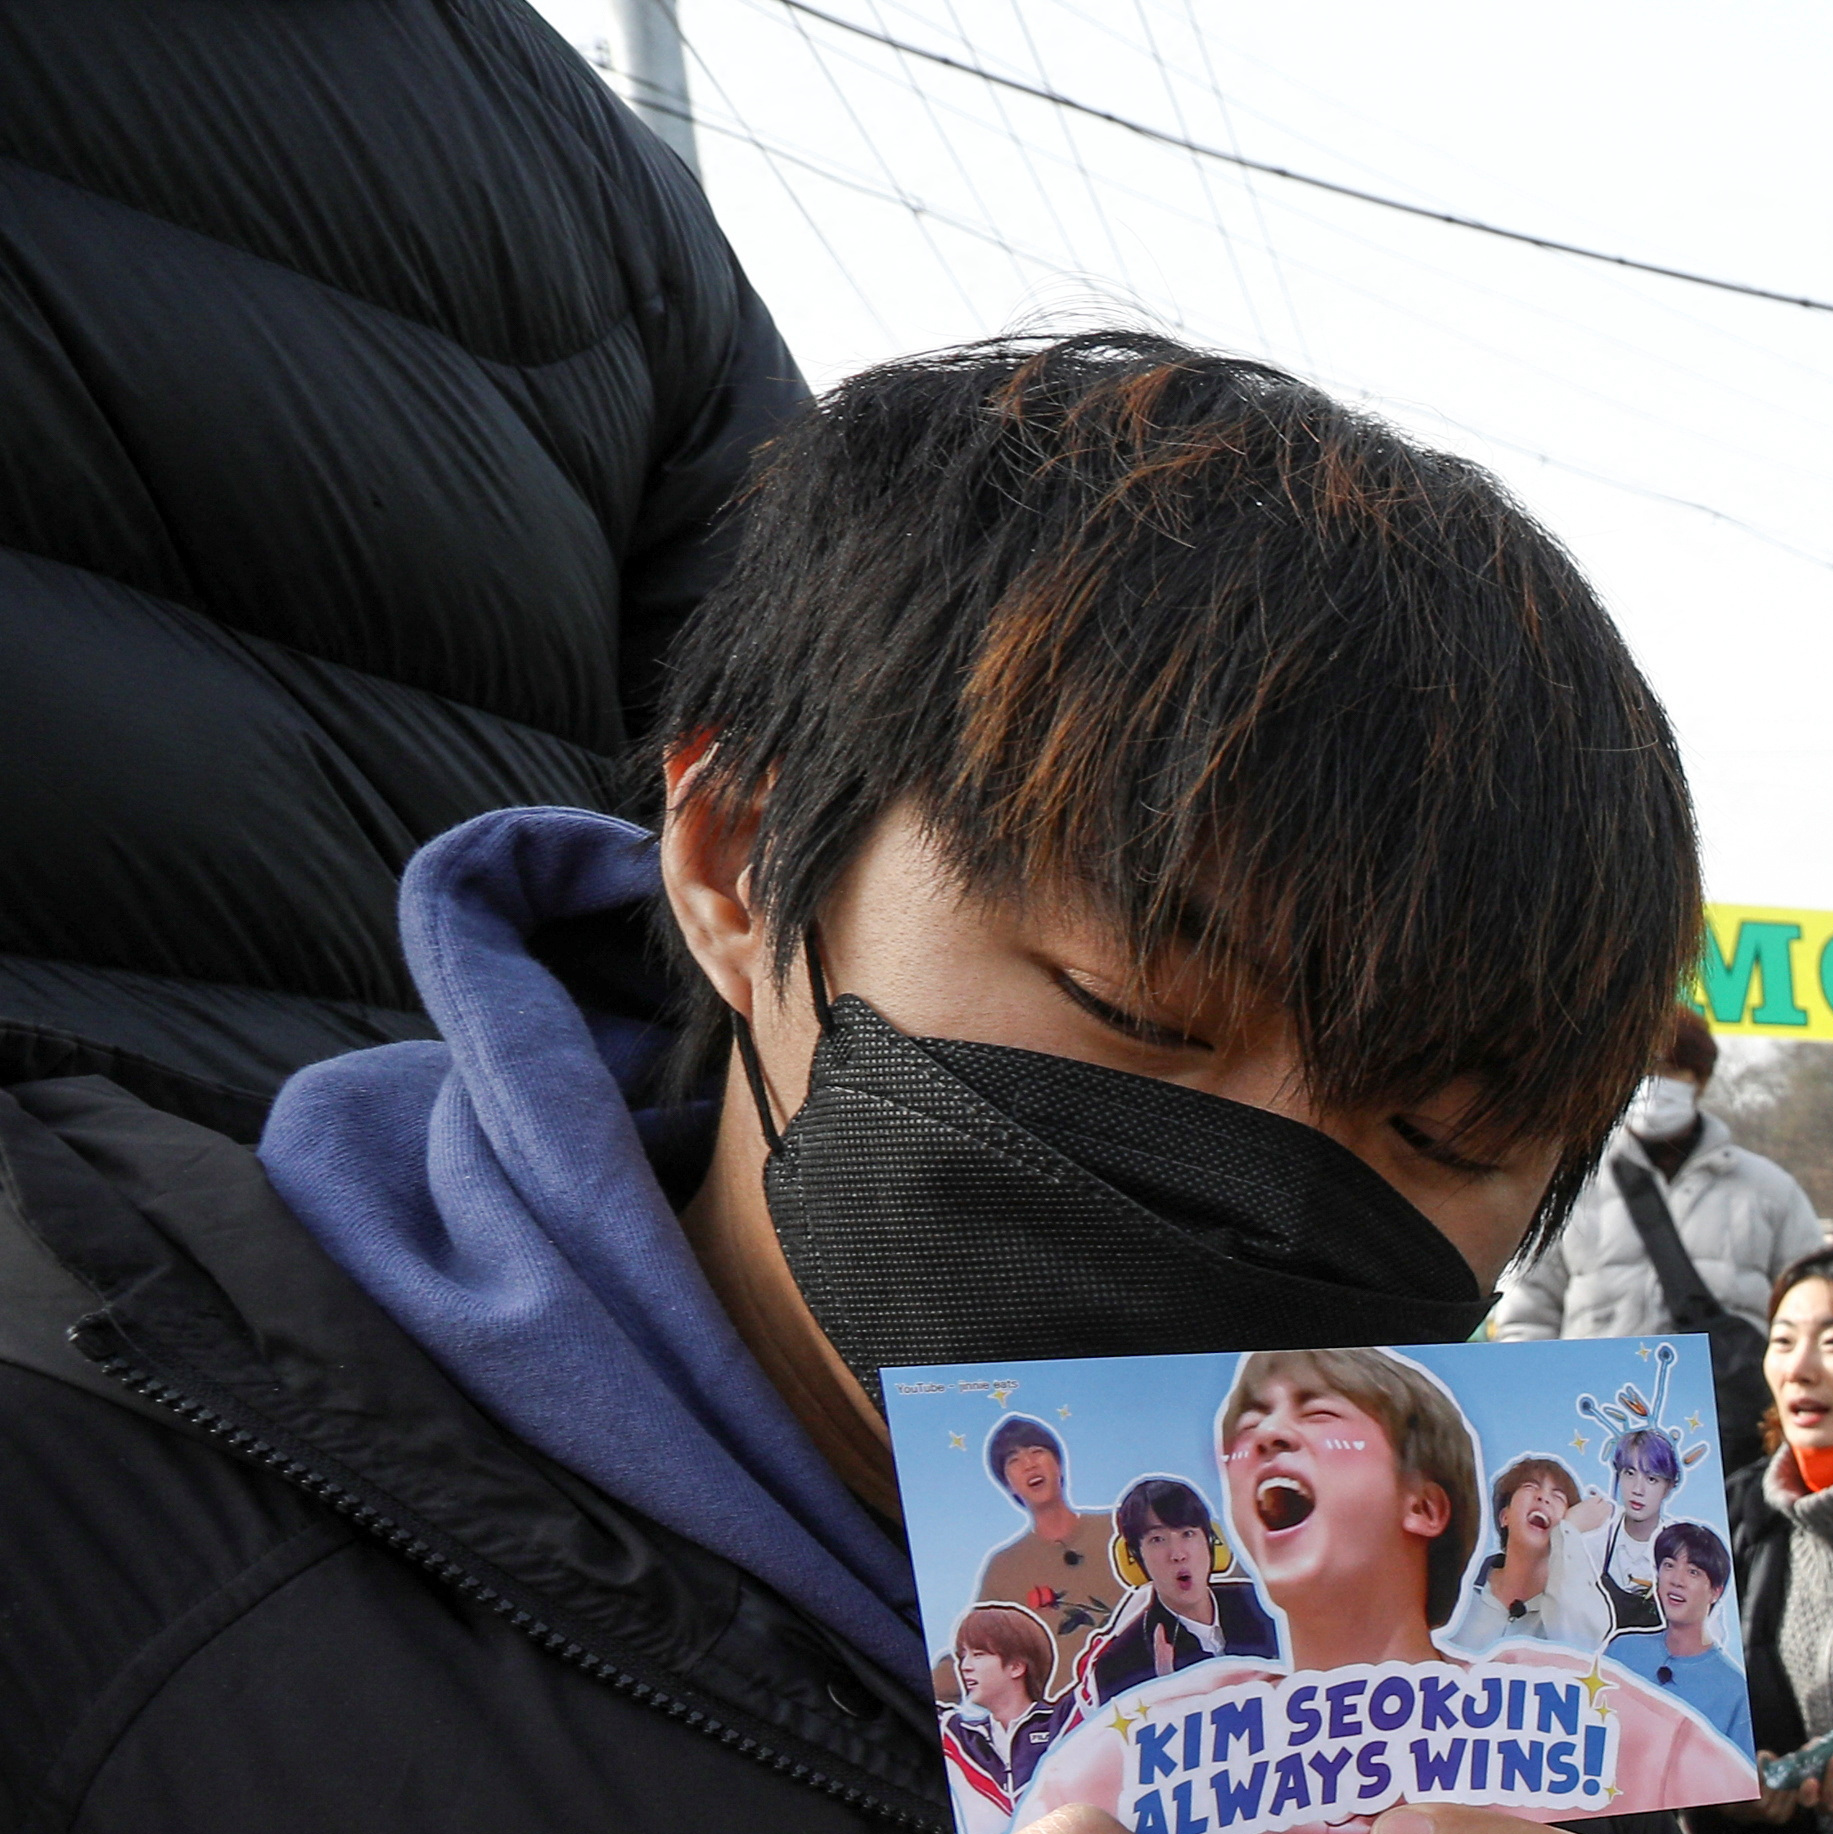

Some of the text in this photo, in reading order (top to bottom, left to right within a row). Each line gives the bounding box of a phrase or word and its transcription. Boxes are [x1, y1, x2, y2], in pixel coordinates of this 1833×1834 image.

[894, 1382, 945, 1395] YouTube
[1135, 1675, 1580, 1786] KIM SEOKJIN
[1410, 1724, 1607, 1797] WINS!
